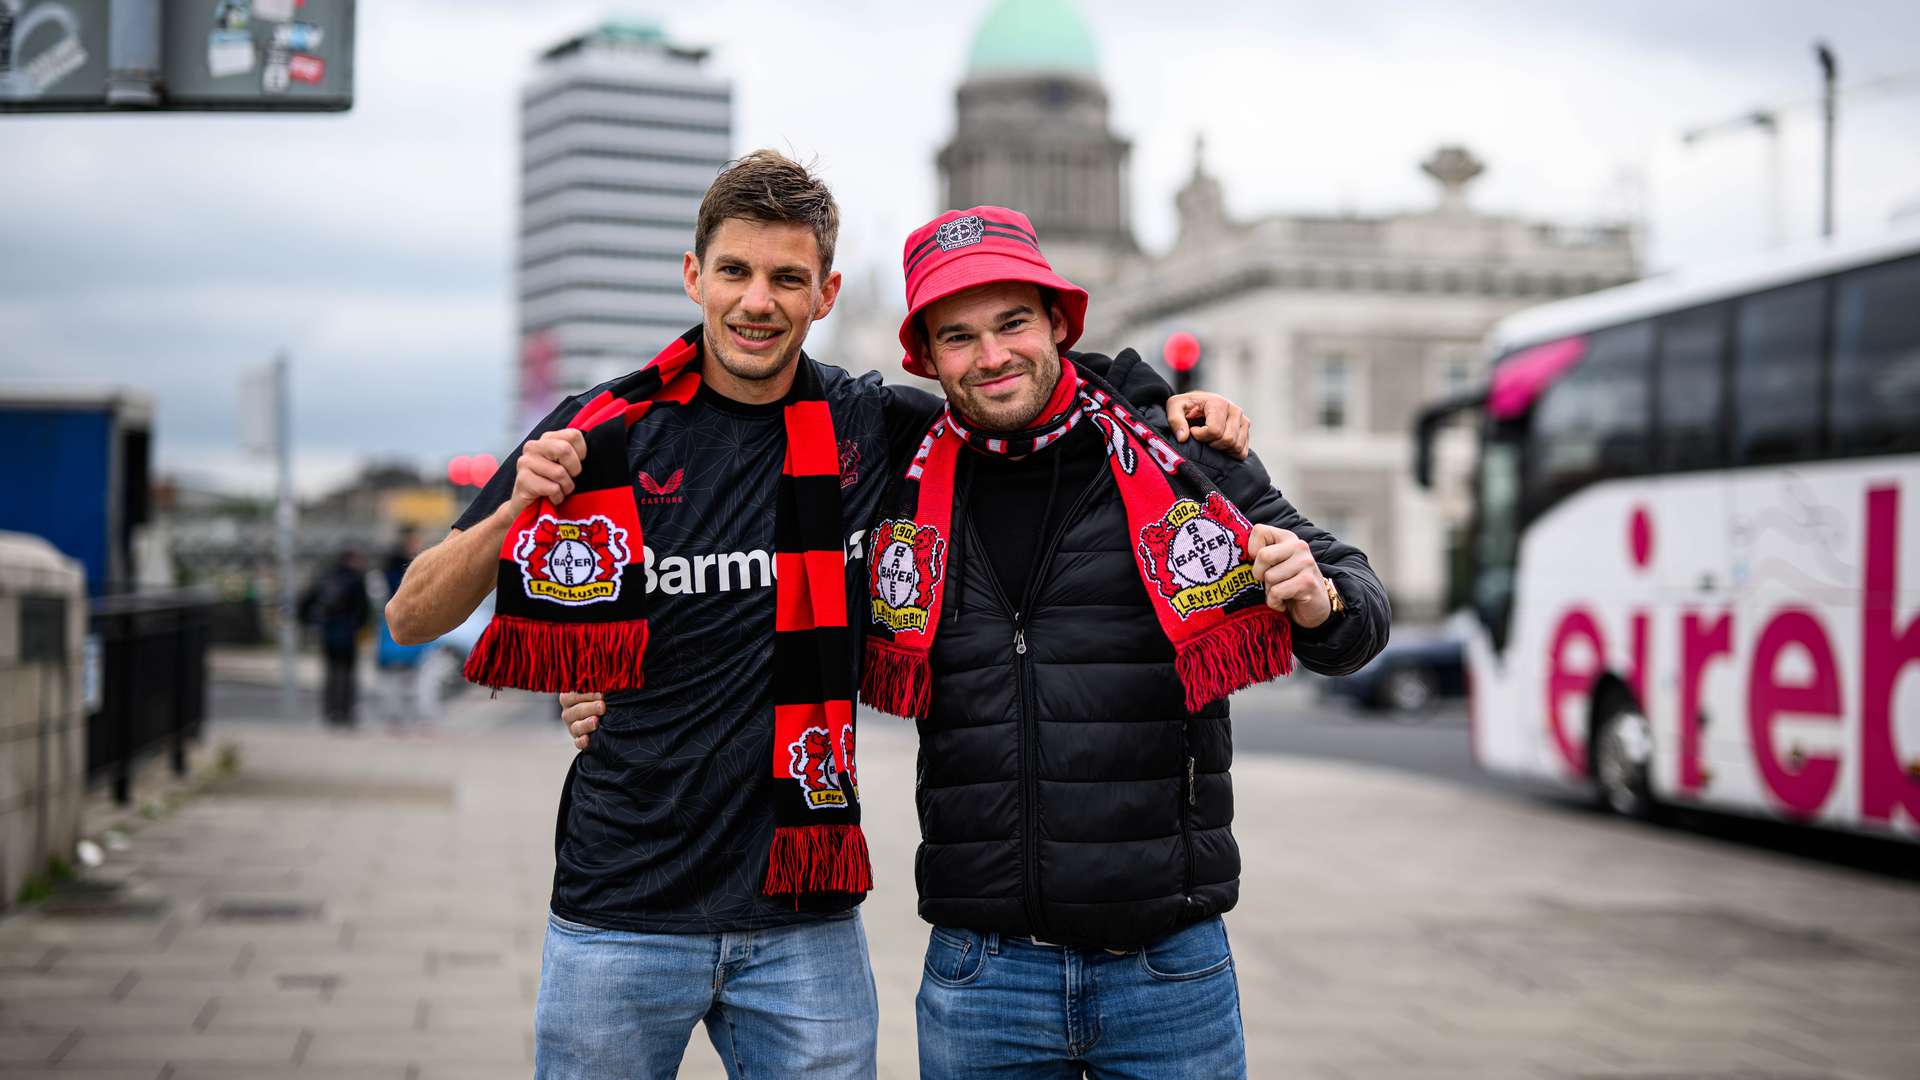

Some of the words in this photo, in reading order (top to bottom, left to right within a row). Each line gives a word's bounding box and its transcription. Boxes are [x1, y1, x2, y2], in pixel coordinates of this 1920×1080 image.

[1172, 504, 1198, 525] 1904
[554, 558, 592, 568] BAYER
[565, 541, 574, 584] BAYER
[1174, 533, 1228, 568] BAYER
[1186, 521, 1218, 579] BAYER
[643, 546, 777, 596] Barm
[881, 566, 913, 584] BAYER
[890, 545, 907, 605] BAYER
[1178, 570, 1255, 609] Leverkusen
[536, 583, 609, 599] Leverkusen
